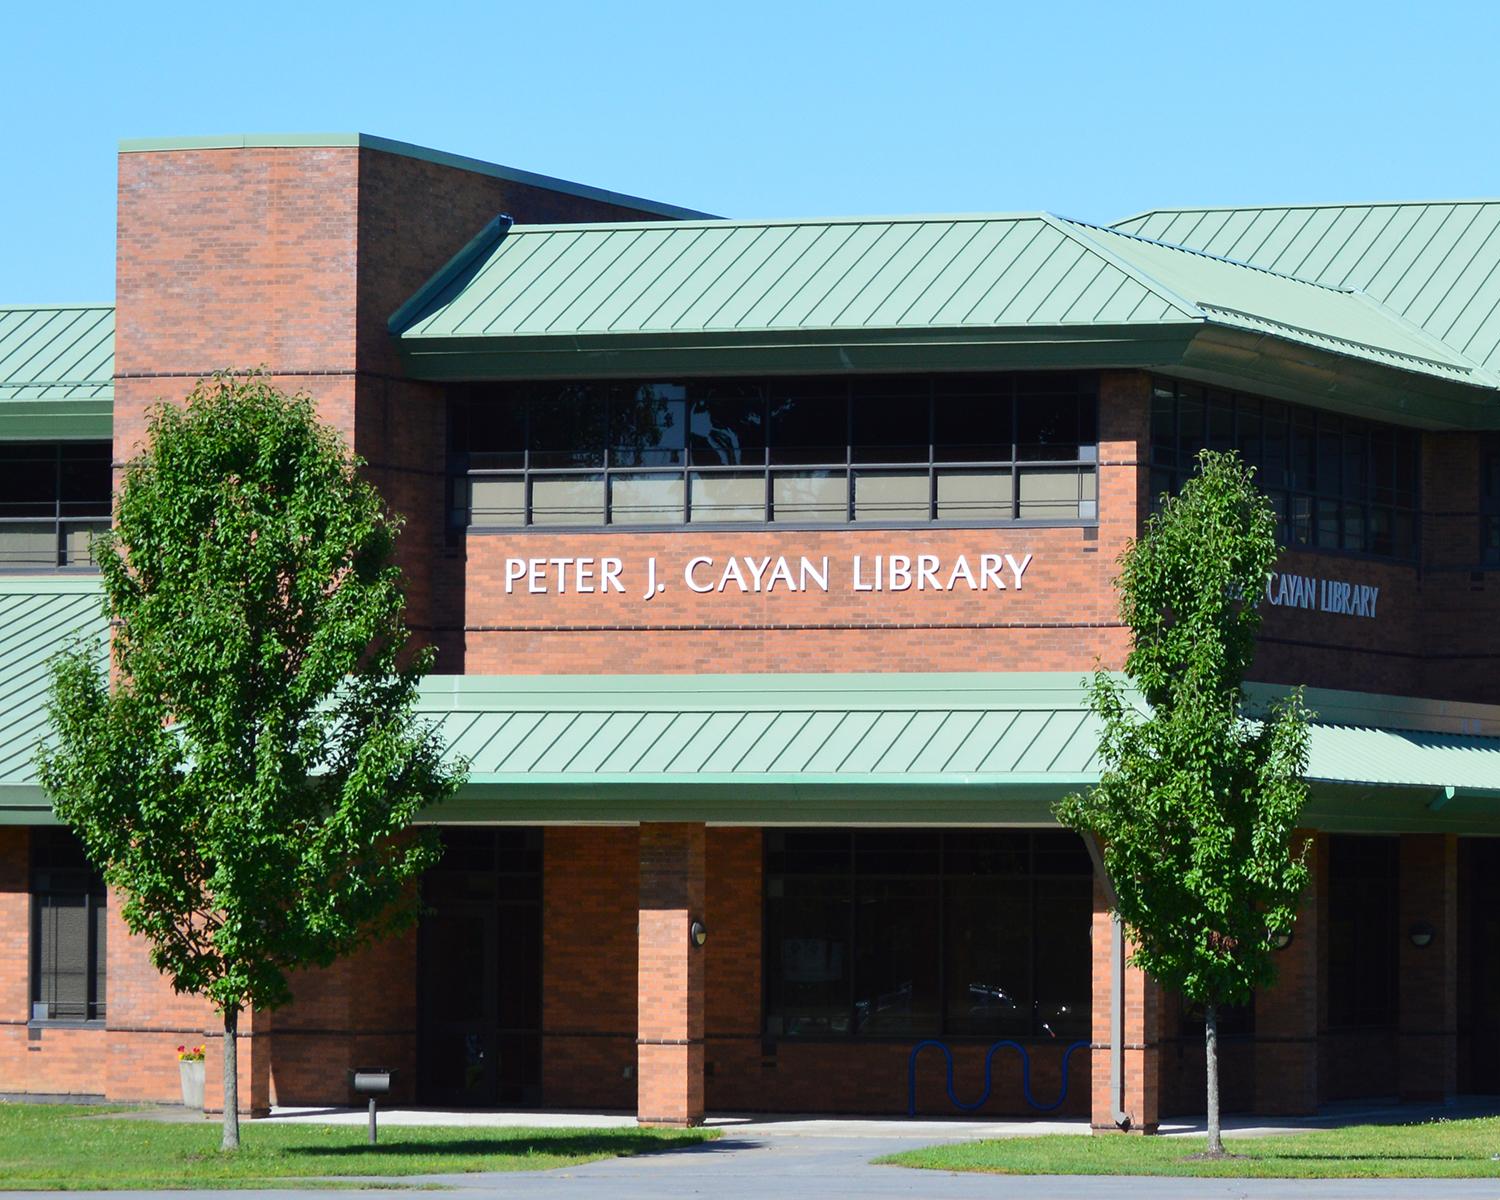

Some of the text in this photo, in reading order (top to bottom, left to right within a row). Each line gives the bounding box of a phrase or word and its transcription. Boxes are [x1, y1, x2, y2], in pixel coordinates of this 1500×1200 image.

[504, 553, 1033, 600] PETER J. CAYAN LIBRARY
[1267, 572, 1316, 609] CAYAN
[1320, 579, 1379, 618] LIBRARY
